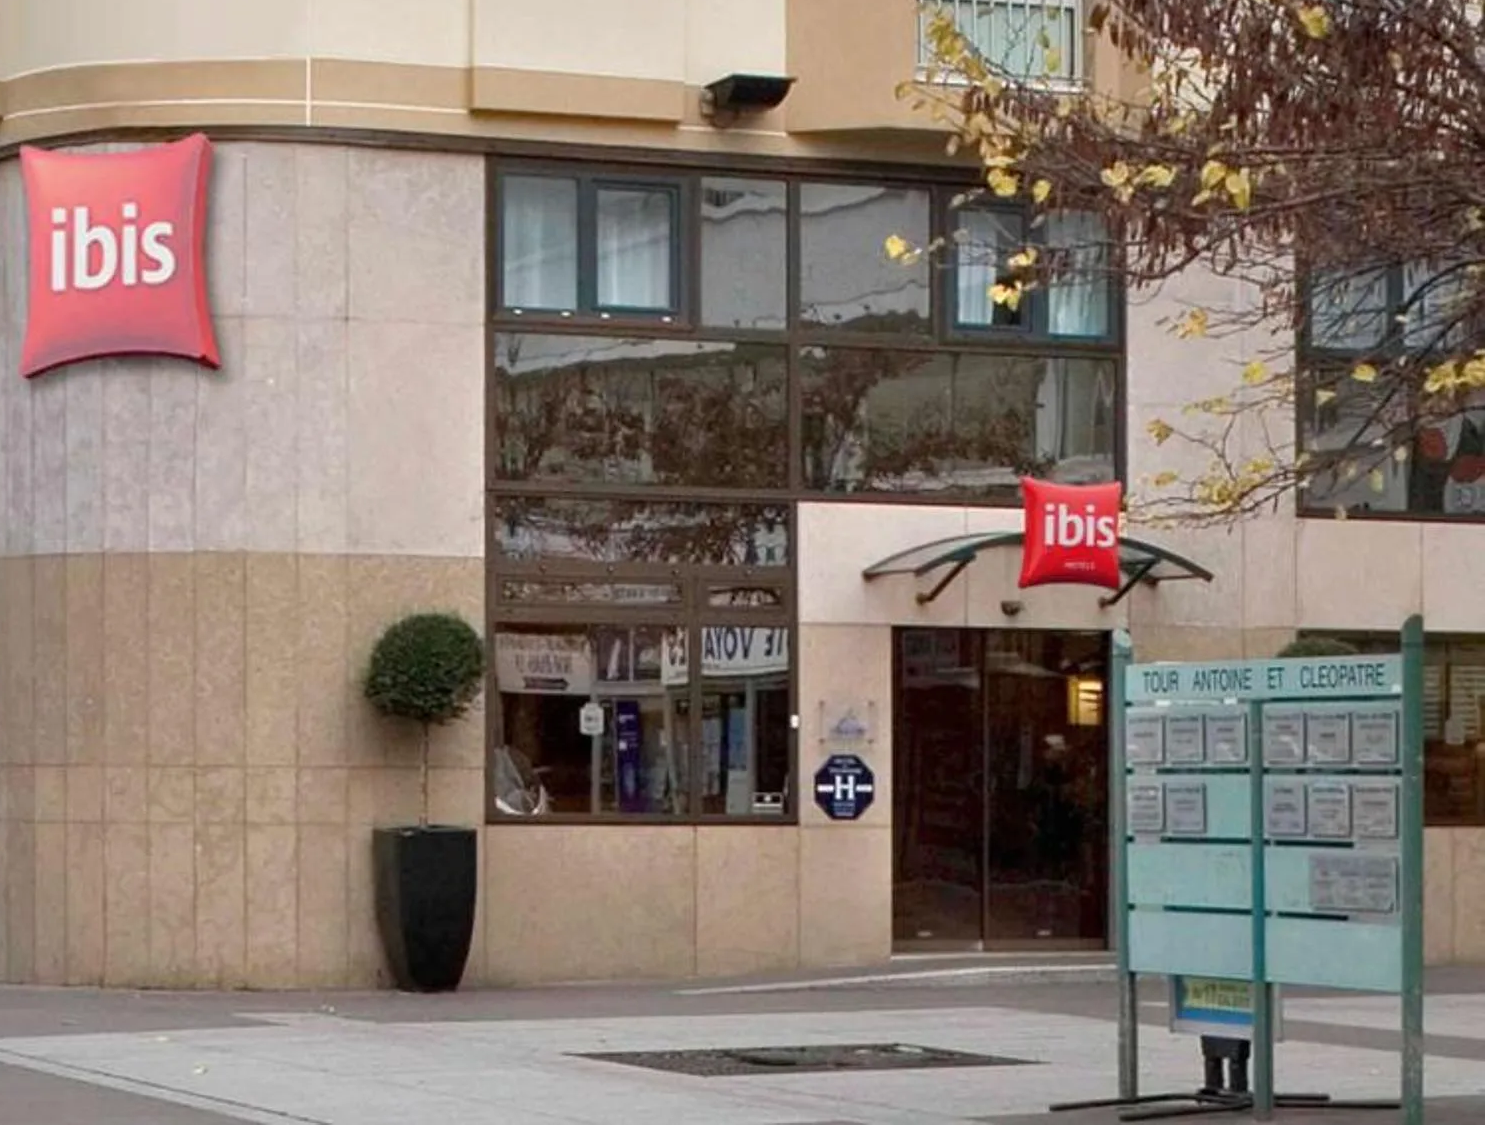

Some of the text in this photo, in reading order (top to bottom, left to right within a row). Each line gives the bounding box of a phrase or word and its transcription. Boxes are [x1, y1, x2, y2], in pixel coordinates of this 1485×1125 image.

[51, 201, 176, 292] ibis
[1043, 502, 1116, 549] ibis
[1142, 663, 1386, 693] TOUR ANTOINE ET CLEOPATRE
[833, 774, 856, 801] H
